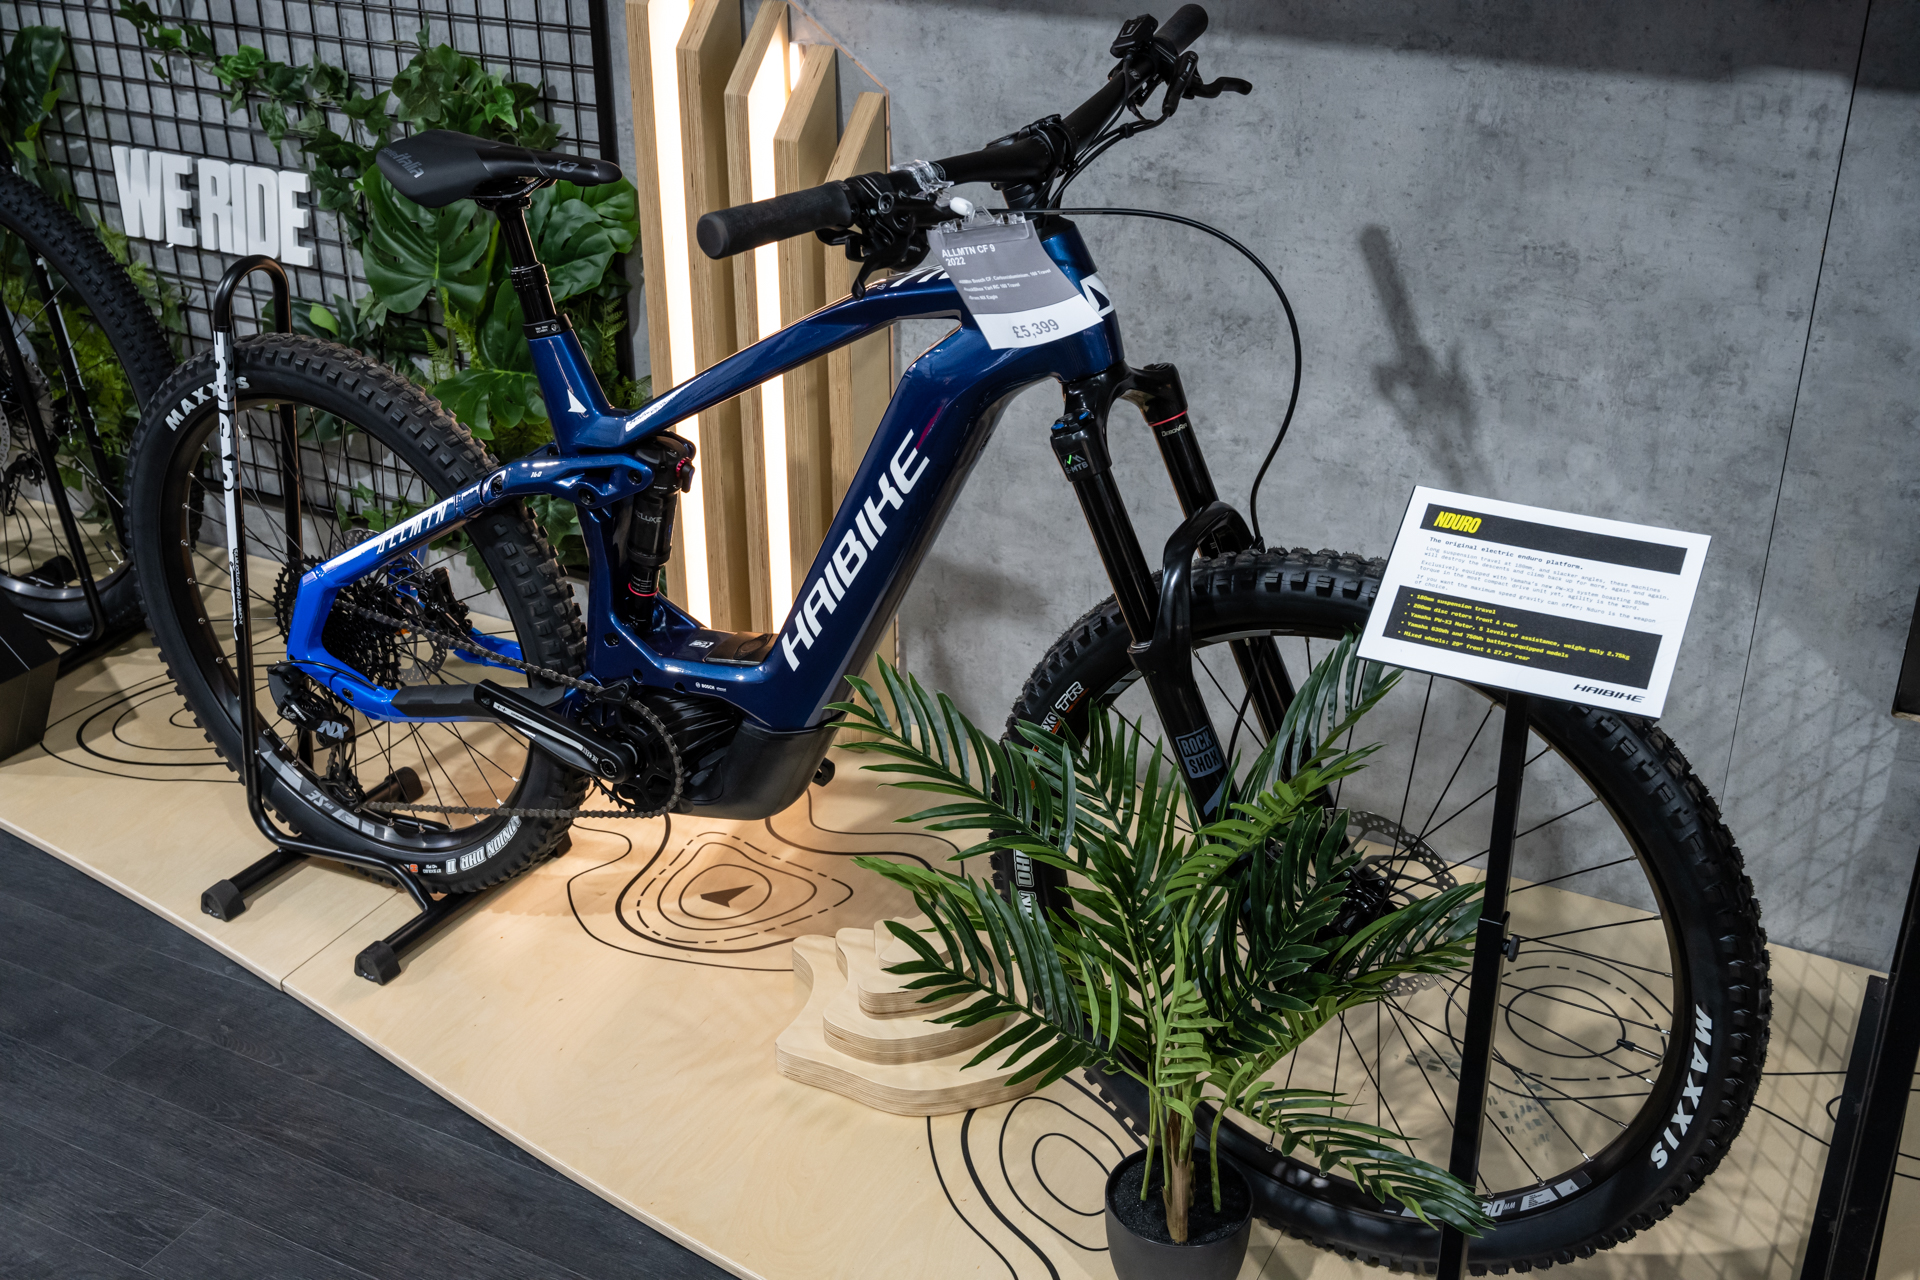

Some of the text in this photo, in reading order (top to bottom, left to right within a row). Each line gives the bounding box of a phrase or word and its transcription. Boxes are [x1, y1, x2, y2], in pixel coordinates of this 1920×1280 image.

[111, 146, 314, 268] WE RIDE
[942, 244, 996, 258] ALLMTN CF 9
[946, 257, 966, 267] 2022
[1012, 319, 1059, 339] £5,399
[1433, 511, 1482, 534] NDURO
[780, 429, 930, 671] HAIBIKE
[1445, 541, 1477, 550] original
[1481, 547, 1514, 557] electric
[1517, 554, 1543, 563] enduro
[1546, 560, 1583, 570] platform.
[1421, 560, 1458, 572] Exclusively
[1462, 569, 1490, 578] equipped
[1510, 578, 1538, 587] Yamaha's
[1602, 594, 1631, 604] boasting
[1426, 546, 1440, 554] Long
[1443, 550, 1478, 559] suspension
[1480, 556, 1501, 564] travel
[1631, 584, 1661, 593] machines
[1441, 555, 1465, 564] destroy
[1482, 563, 1510, 572] descents
[1589, 580, 1607, 590] more,
[1424, 582, 1448, 590] choice.
[1470, 586, 1496, 594] maximum
[1518, 595, 1544, 604] gravity
[1437, 599, 1472, 609] suspension
[1475, 606, 1496, 615] travel
[1568, 595, 1593, 603] agility
[1404, 631, 1422, 639] Mixed
[1424, 636, 1449, 644] wheels:
[1408, 621, 1428, 630] Yamaha
[1486, 638, 1544, 653] battery-equipped
[1411, 612, 1432, 621] Yamaha
[1454, 621, 1475, 630] Motor,
[1486, 628, 1508, 636] levels
[1521, 636, 1560, 647] assistance,
[1055, 681, 1084, 712] TR
[1573, 684, 1644, 702] HAIBIKE
[1041, 711, 1062, 732] XO
[1180, 730, 1212, 756] ROCK
[1188, 750, 1220, 774] SHOX
[460, 846, 486, 872] DHR
[1650, 1004, 1714, 1170] MAXXIS
